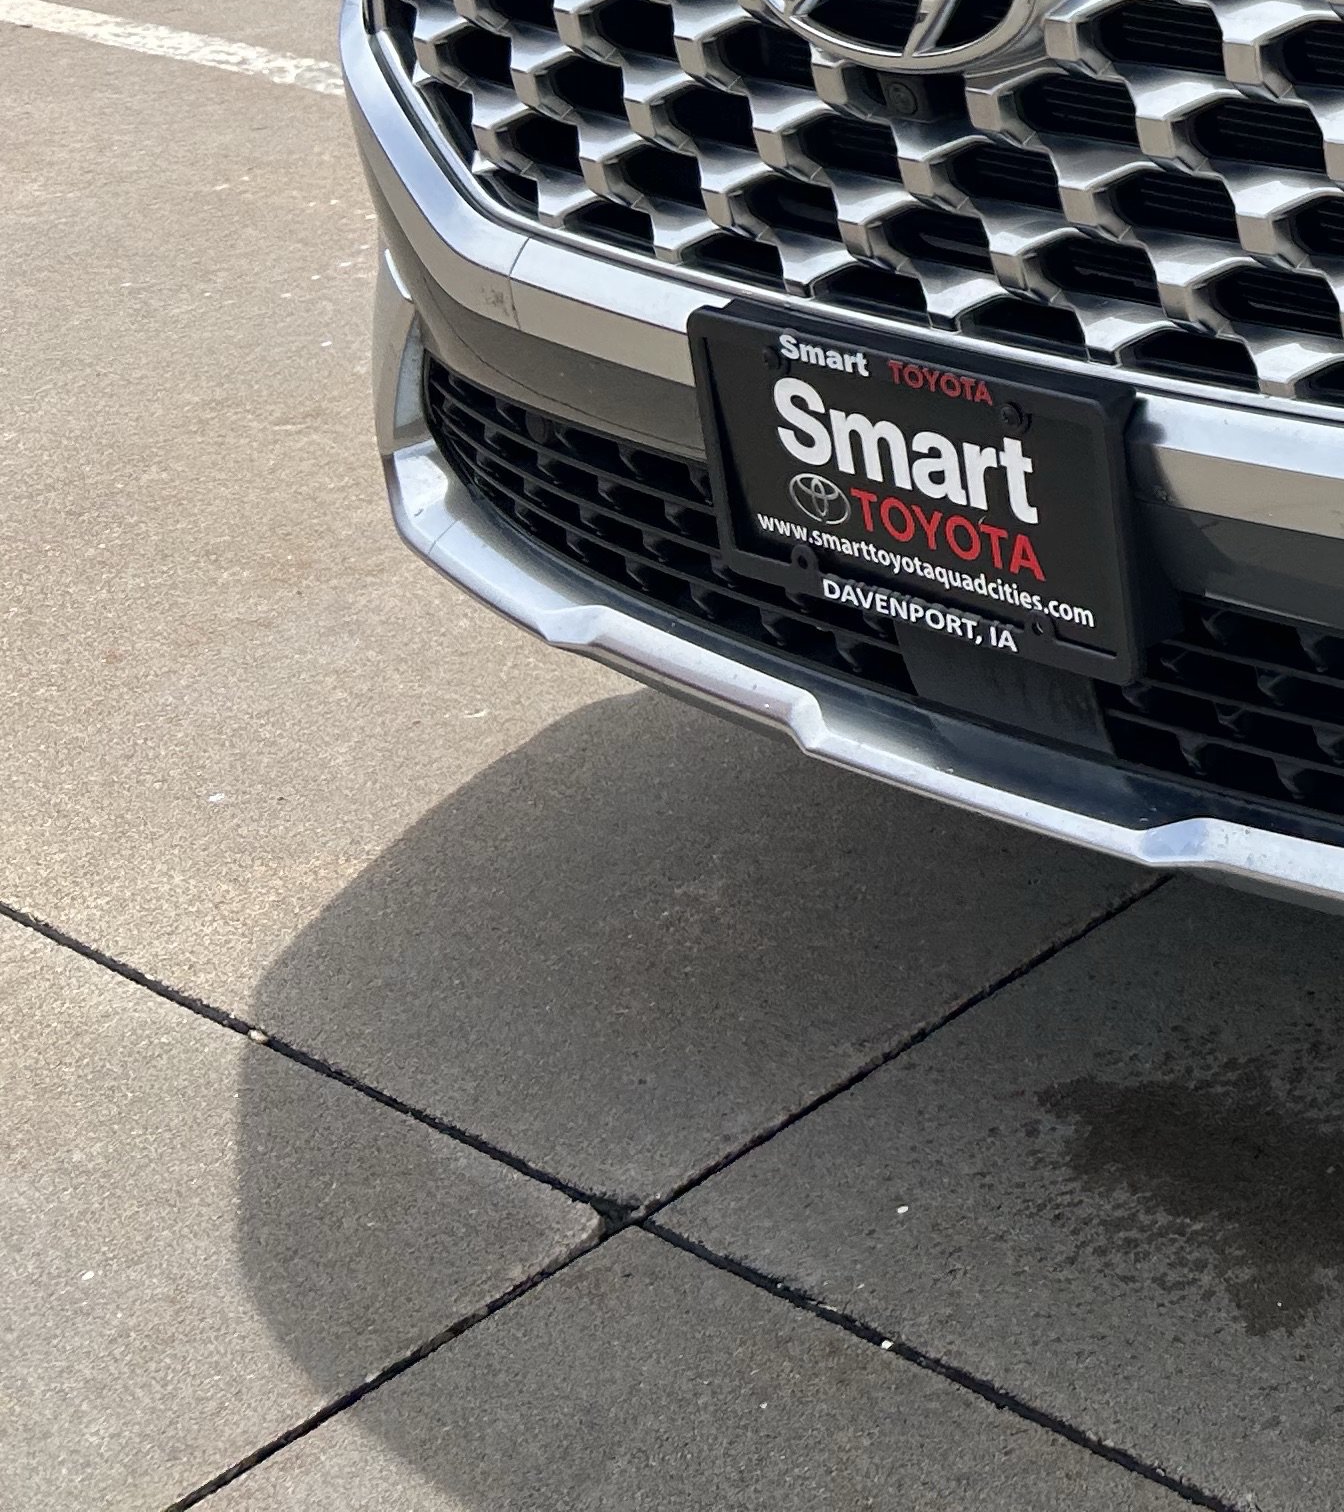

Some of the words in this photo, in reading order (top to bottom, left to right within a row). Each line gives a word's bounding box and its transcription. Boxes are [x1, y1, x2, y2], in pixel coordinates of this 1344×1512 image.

[779, 334, 870, 378] Smart
[887, 360, 993, 406] TOYOTA
[773, 377, 1040, 525] Smart
[757, 512, 1096, 629] www.smarttoyotaquadcities.com
[850, 488, 1047, 582] TOYOTA
[822, 578, 984, 646] DAVENPORT,
[990, 625, 1019, 653] IA
